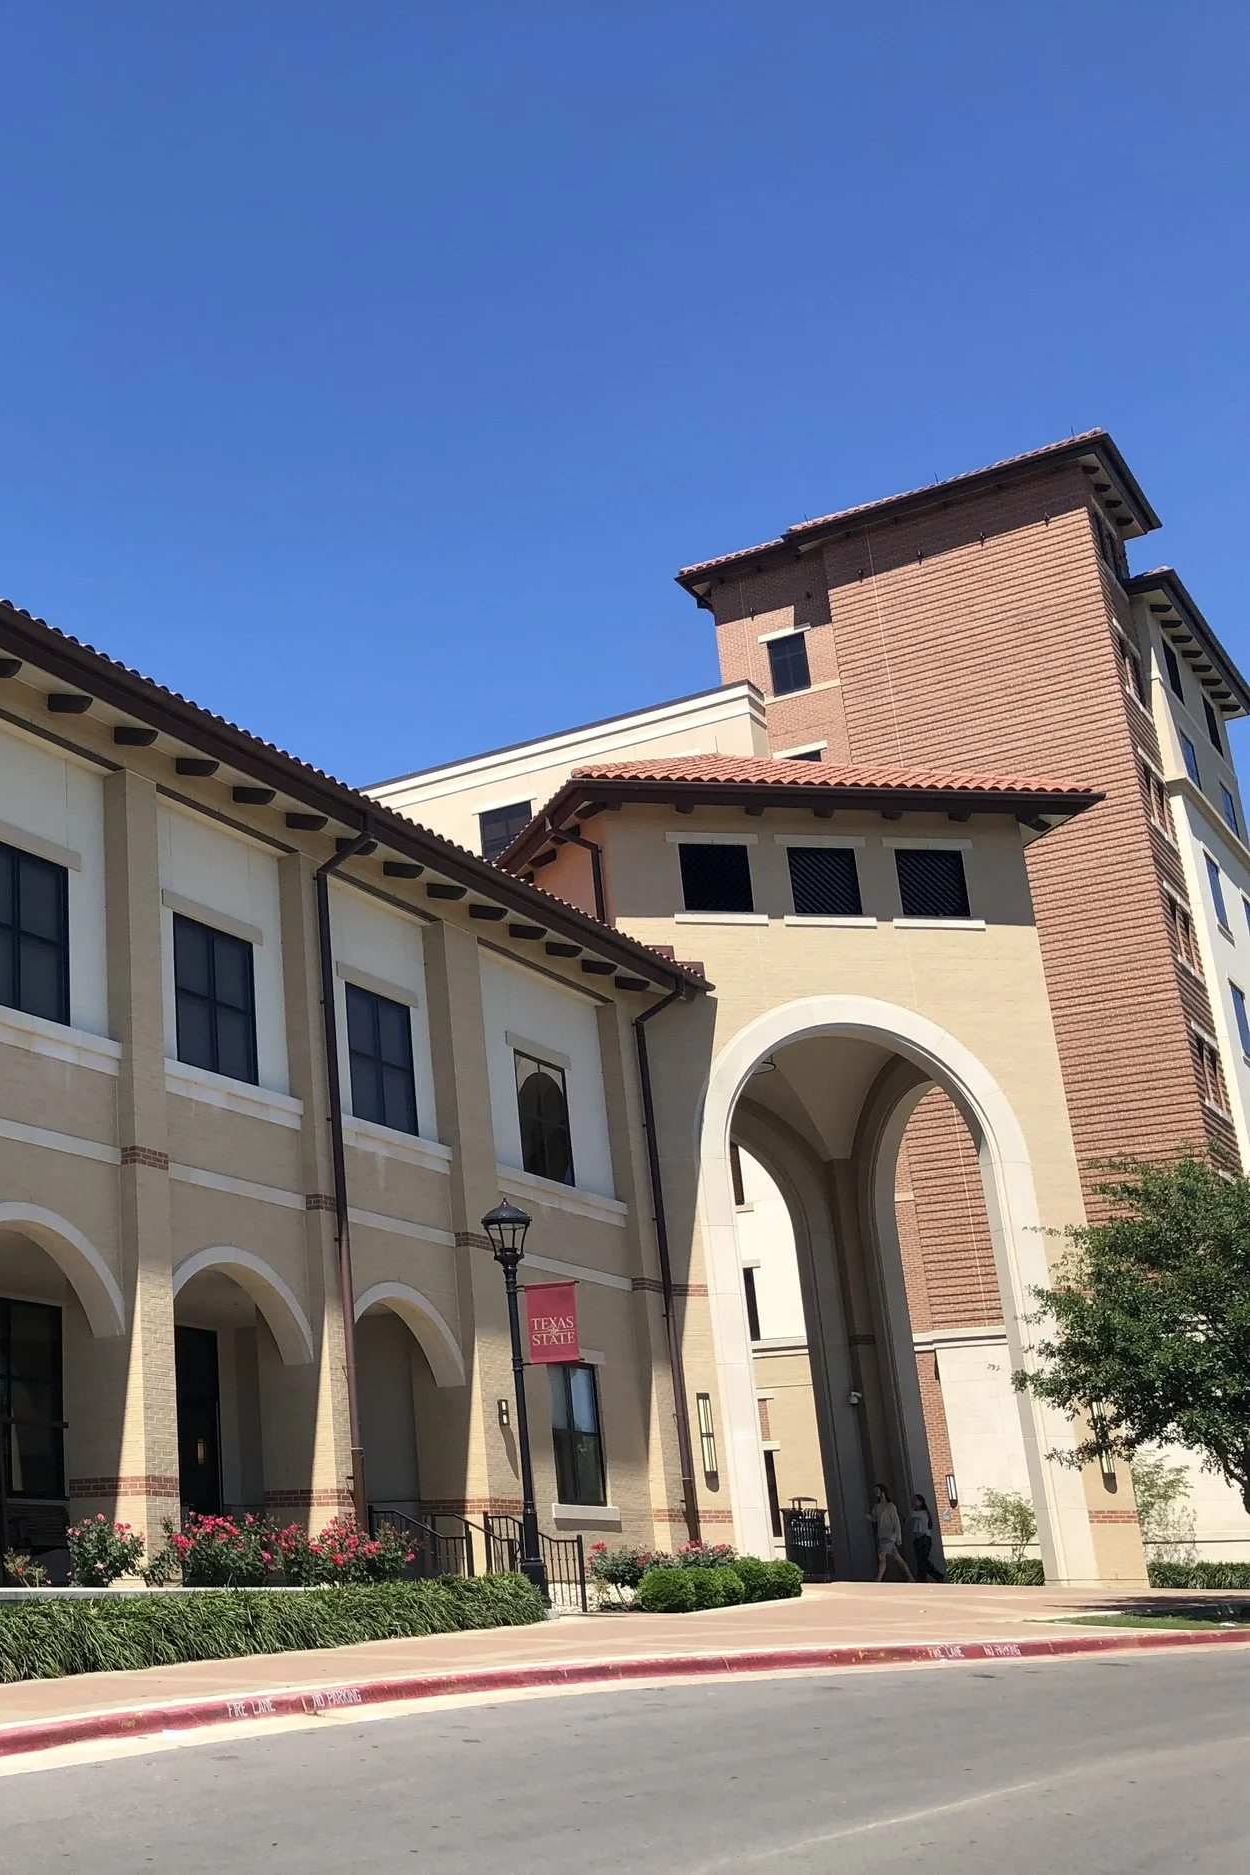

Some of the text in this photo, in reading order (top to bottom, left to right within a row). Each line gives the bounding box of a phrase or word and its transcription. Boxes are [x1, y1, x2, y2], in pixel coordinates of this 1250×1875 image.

[531, 1316, 574, 1331] TEXAS
[532, 1331, 575, 1346] STATE
[311, 1688, 362, 1707] NO PARKING
[226, 1698, 276, 1717] FIRE LANE
